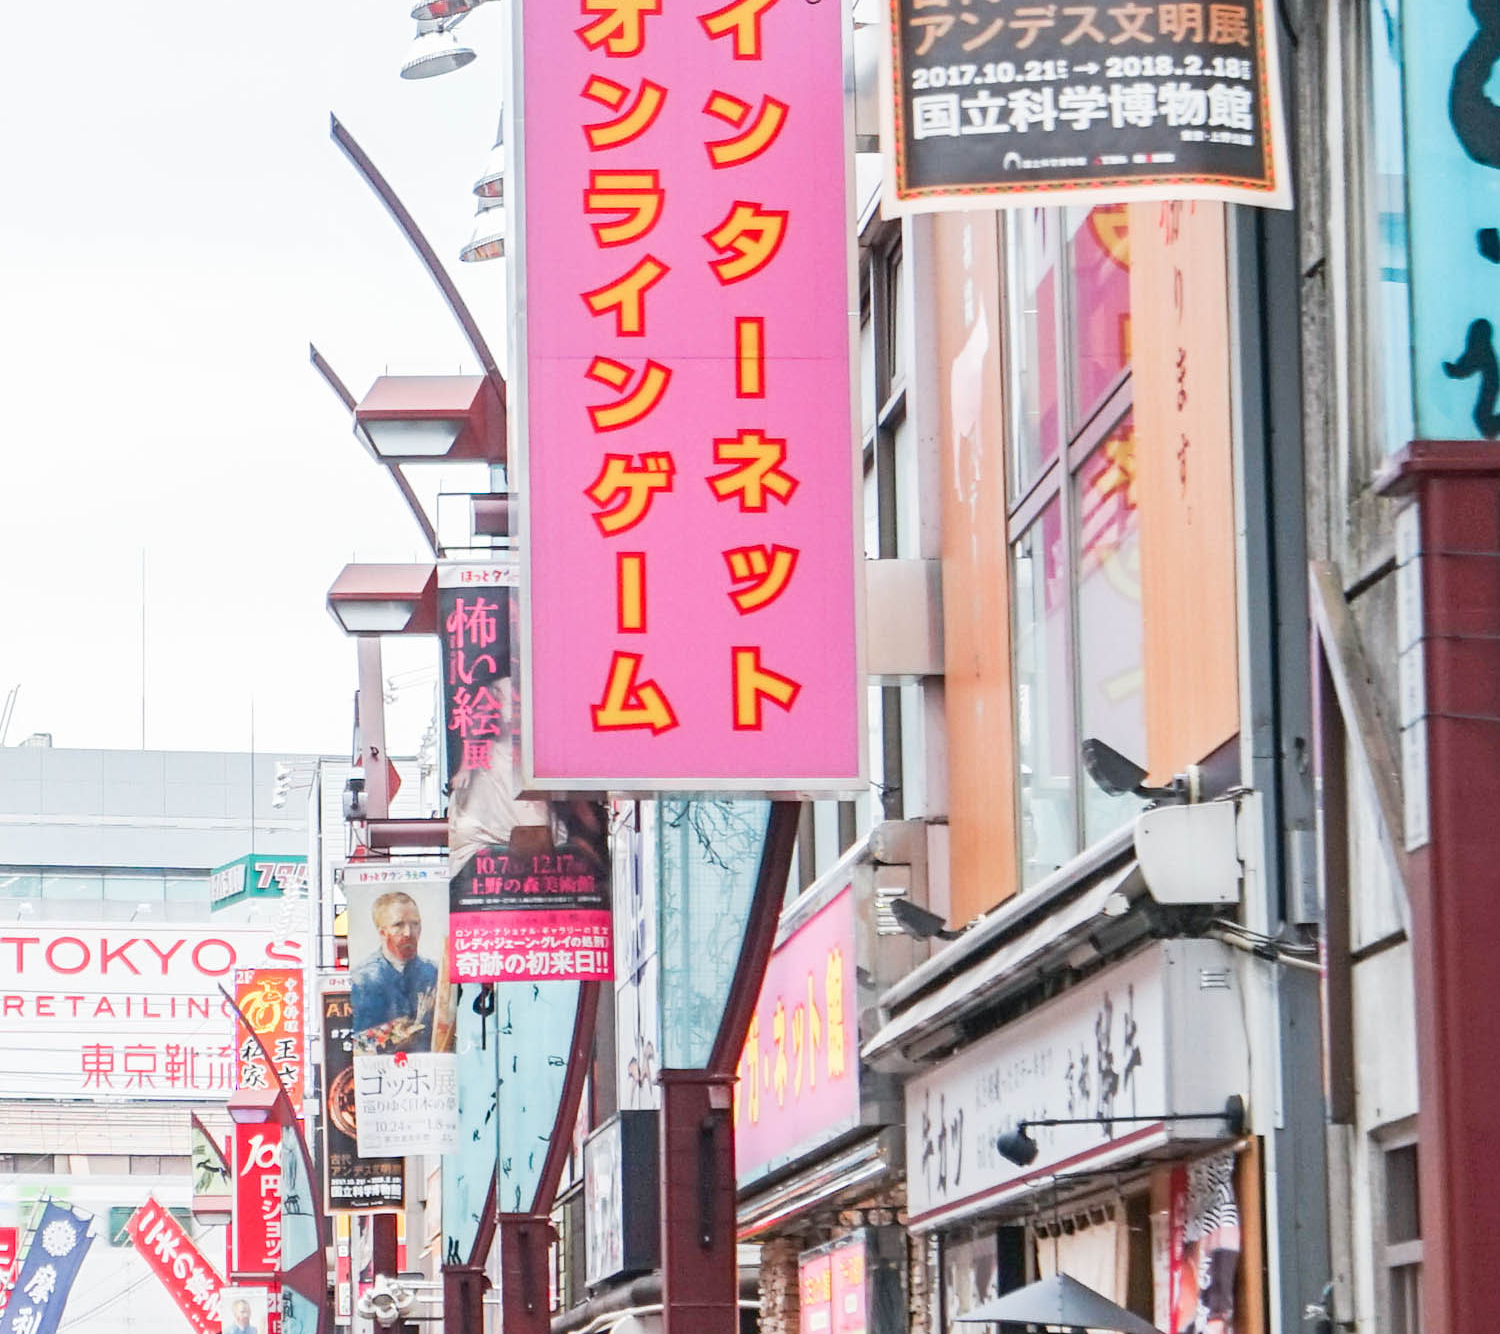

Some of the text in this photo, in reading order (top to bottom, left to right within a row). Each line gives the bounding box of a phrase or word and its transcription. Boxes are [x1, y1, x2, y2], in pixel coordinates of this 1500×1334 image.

[909, 2, 1250, 56] アンデス文明展
[912, 82, 1255, 141] 国立科学博物館
[446, 597, 499, 772] 怖い絵展
[1, 936, 237, 976] TOKYO
[456, 951, 609, 978] 奇跡の初来日!!
[237, 971, 255, 984] 2F
[361, 1069, 457, 1097] ゴッホ展
[362, 1098, 457, 1114] 巡りゆく日本の夢
